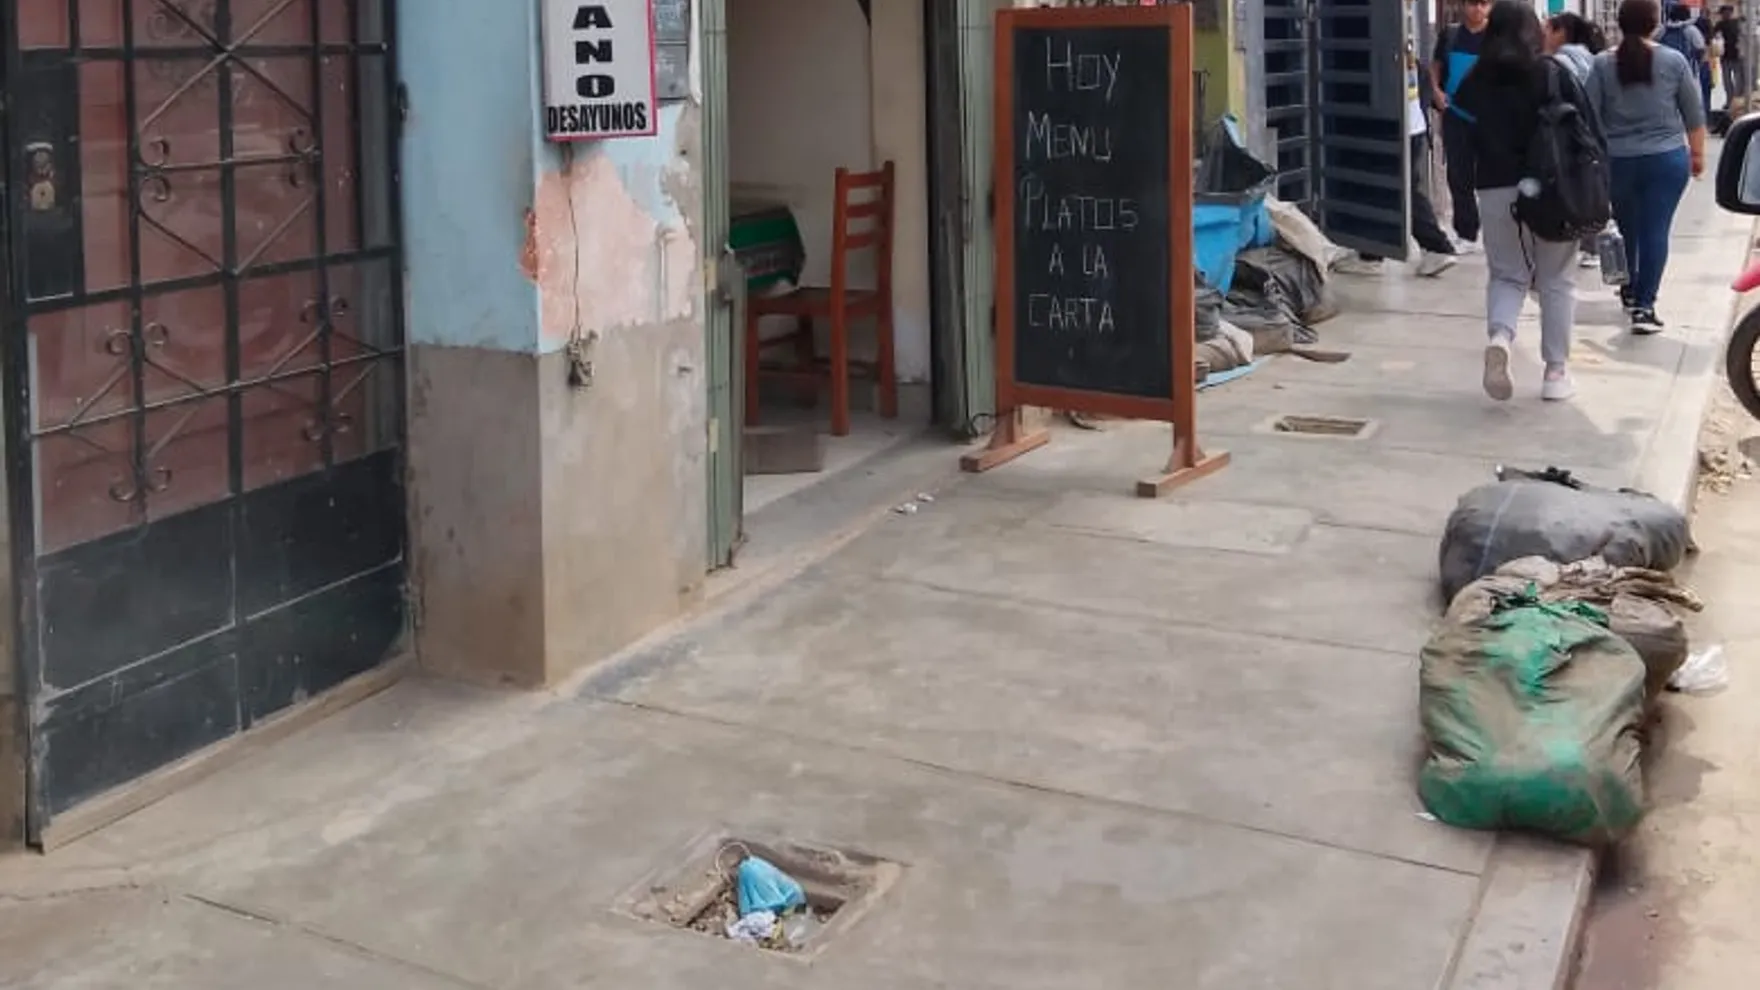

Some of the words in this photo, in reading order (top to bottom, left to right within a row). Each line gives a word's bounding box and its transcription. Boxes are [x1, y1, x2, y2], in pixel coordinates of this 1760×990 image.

[547, 102, 647, 133] DESAYUNOS
[1026, 110, 1112, 161] MENU
[1020, 173, 1139, 230] PLATOS
[1049, 243, 1064, 274] A
[1082, 244, 1108, 277] LA
[1028, 293, 1115, 333] CARTA
